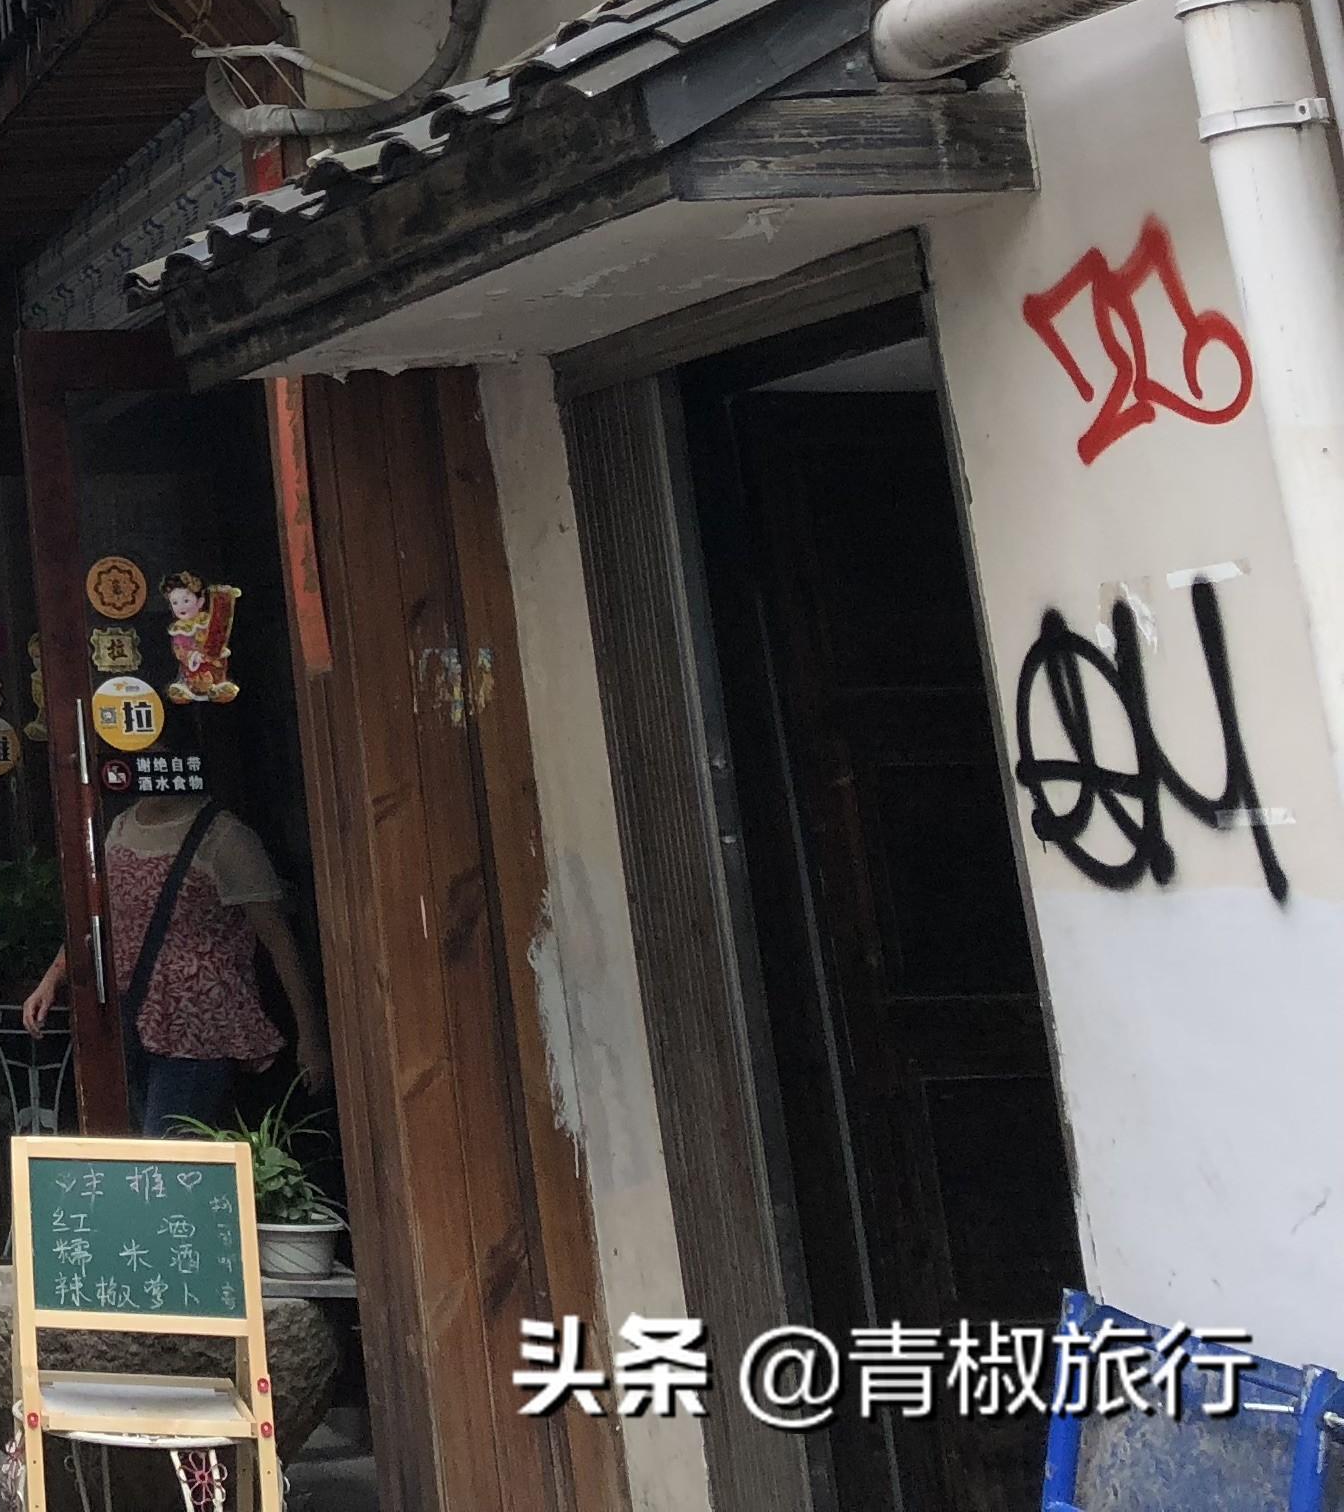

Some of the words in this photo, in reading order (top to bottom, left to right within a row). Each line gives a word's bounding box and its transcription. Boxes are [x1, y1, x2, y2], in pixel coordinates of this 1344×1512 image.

[106, 638, 128, 661] 拉
[122, 700, 155, 733] 拉
[136, 756, 202, 774] 谢绝自带
[138, 774, 204, 793] 酒水食物
